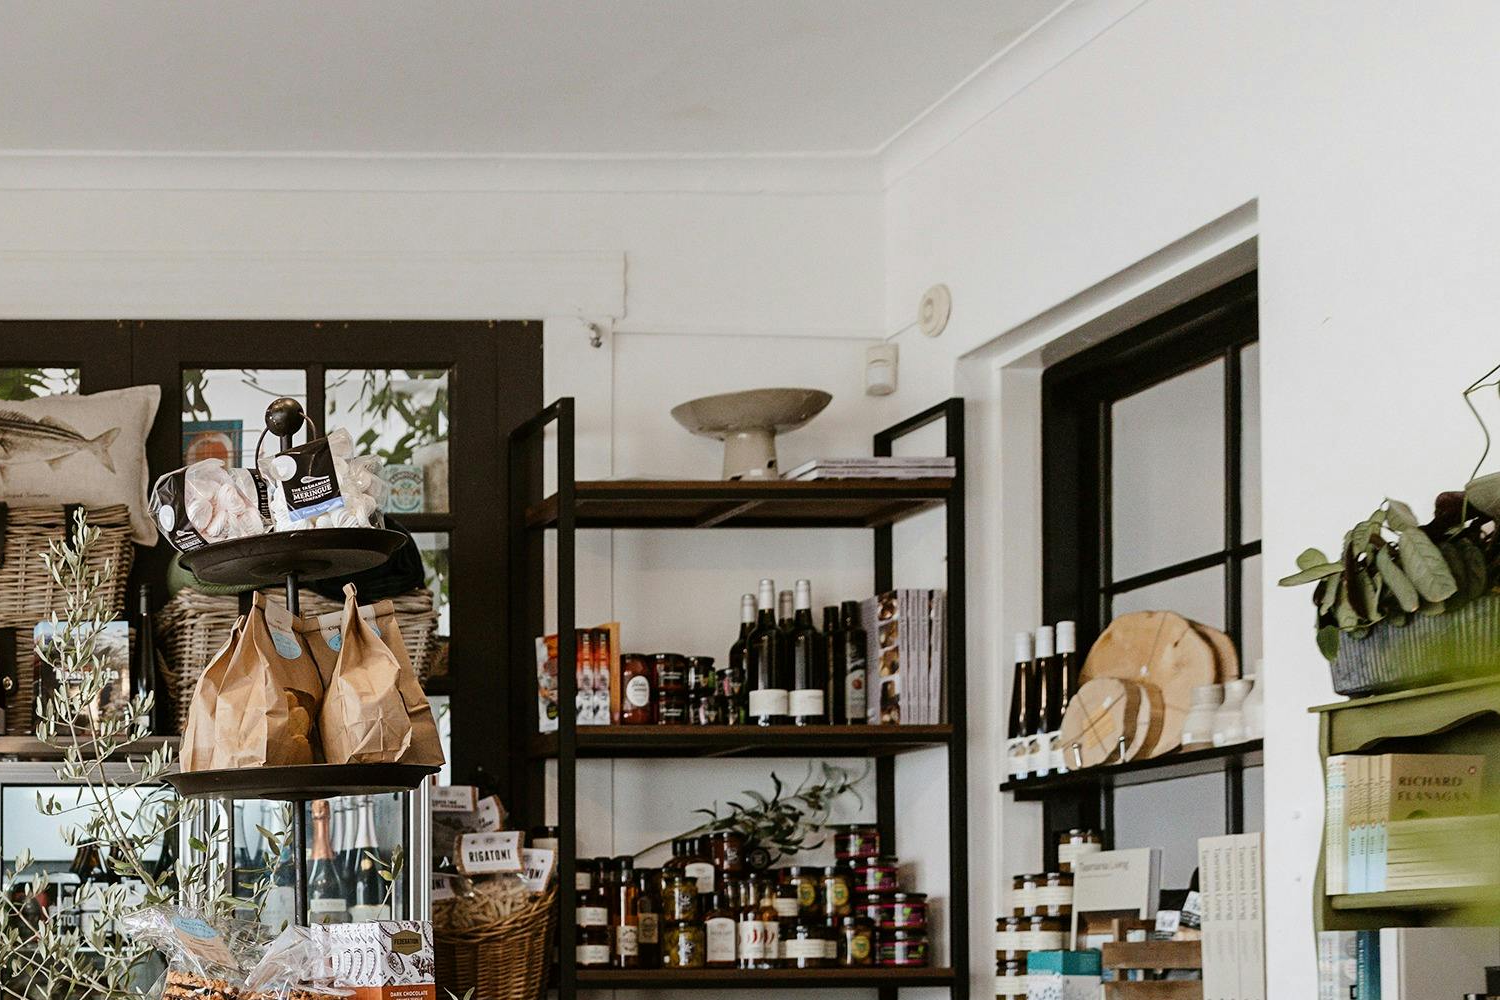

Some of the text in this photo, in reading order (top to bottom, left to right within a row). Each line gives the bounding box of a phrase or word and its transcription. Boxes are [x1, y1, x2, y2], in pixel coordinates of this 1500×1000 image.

[301, 478, 330, 491] TASMANIAN
[293, 484, 332, 500] MERINGUE
[1398, 776, 1463, 787] RICHARD
[1397, 791, 1471, 801] FLANAGAN
[468, 849, 511, 862] RIGATONI
